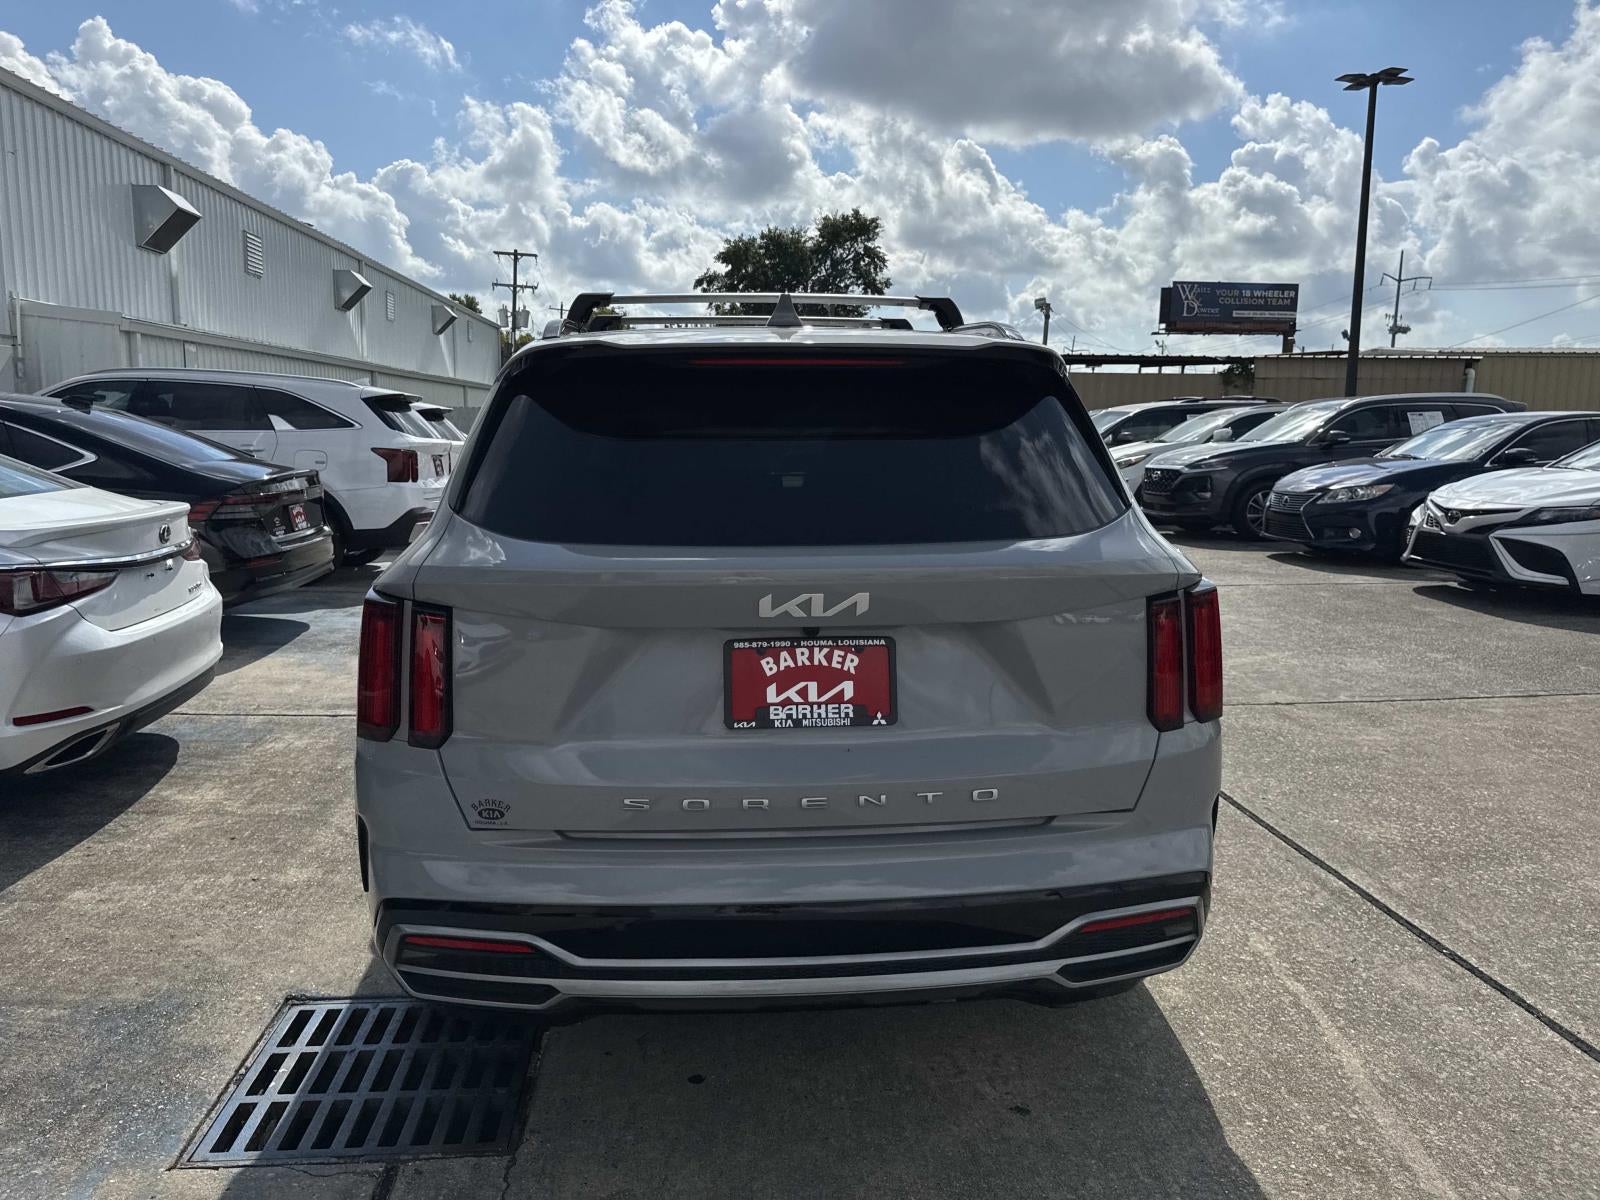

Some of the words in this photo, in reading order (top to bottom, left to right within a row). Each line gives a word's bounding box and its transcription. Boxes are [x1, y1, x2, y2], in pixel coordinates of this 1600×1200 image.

[1215, 289, 1239, 298] YOUR
[1242, 290, 1251, 298] 18
[1253, 290, 1296, 298] WHEELER
[1218, 297, 1265, 306] COLLISION
[1267, 298, 1291, 306] TEAM
[758, 592, 870, 618] KIA
[733, 640, 791, 649] 985-879-1990
[838, 639, 886, 647] LOUISIANA
[760, 647, 860, 677] BARKER
[766, 680, 854, 704] KIA
[769, 703, 854, 720] BARKER
[774, 719, 794, 728] KIA
[802, 718, 851, 727] MITSUBISHI
[471, 798, 511, 813] BARKER
[622, 788, 999, 811] SORENTO
